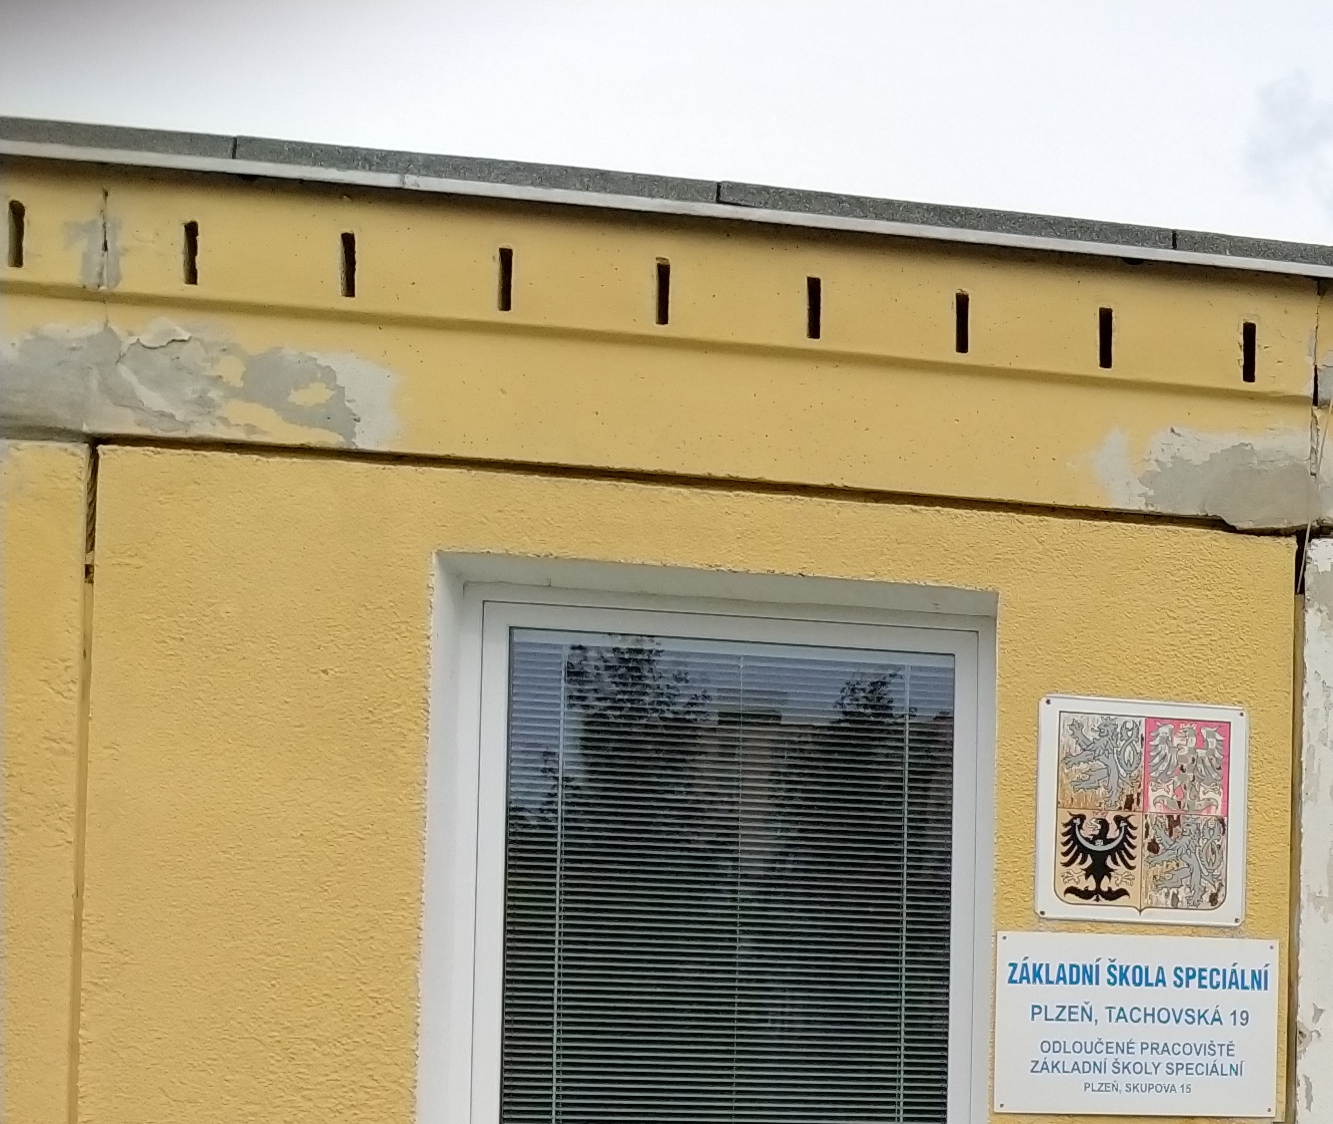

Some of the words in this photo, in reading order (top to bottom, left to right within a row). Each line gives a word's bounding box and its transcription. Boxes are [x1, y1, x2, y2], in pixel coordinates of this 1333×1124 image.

[1007, 956, 1102, 986] ZÁKLADNÍ
[1106, 958, 1167, 988] ŠKOLA
[1172, 962, 1270, 991] SPECIÁLNÍ
[1030, 1001, 1098, 1026] PLZEŇ,
[1105, 1005, 1223, 1026] TACHOVSKÁ
[1229, 1010, 1250, 1026] 19
[1040, 1038, 1136, 1055] ODLOUČENÉ
[1140, 1040, 1236, 1057] PRACOVIŠTĚ
[1029, 1056, 1108, 1074] ZÁKLADNÍ
[1111, 1058, 1161, 1075] ŠKOLY
[1165, 1059, 1245, 1077] SPECIÁLNÍ
[1083, 1080, 1122, 1094] PLZEŇ,
[1125, 1083, 1177, 1094] SKUPOVA
[1180, 1083, 1192, 1094] 15
